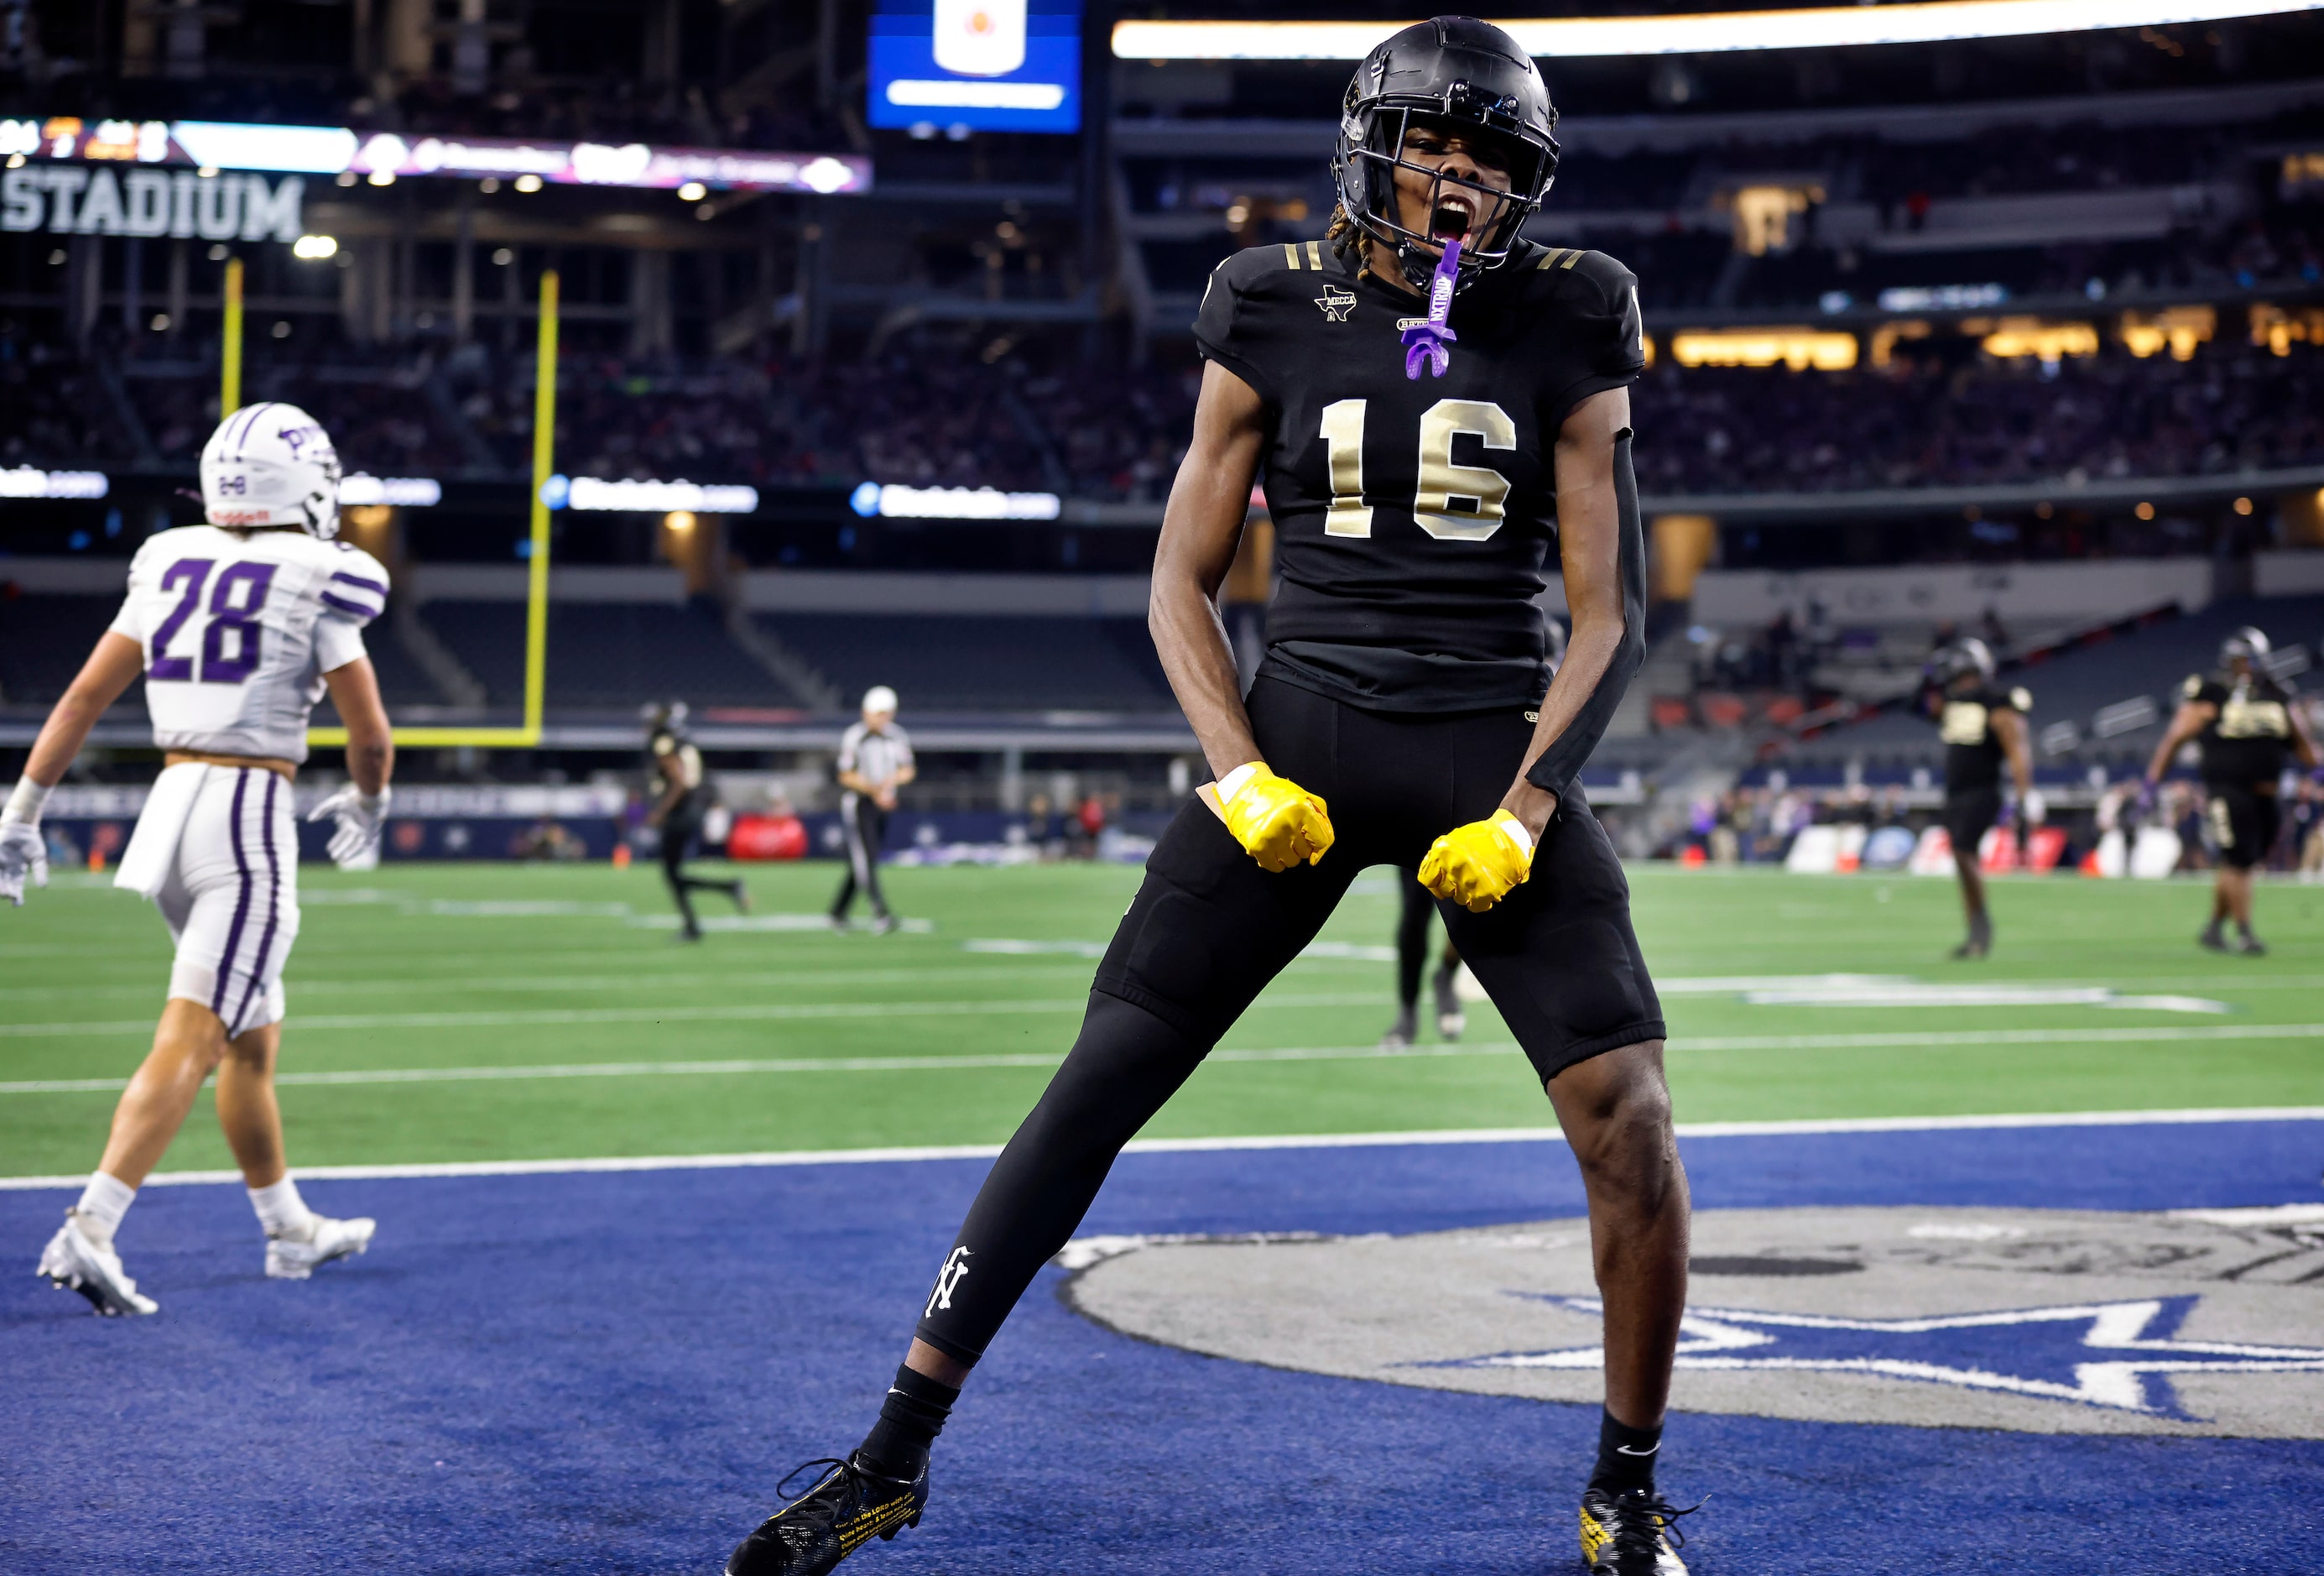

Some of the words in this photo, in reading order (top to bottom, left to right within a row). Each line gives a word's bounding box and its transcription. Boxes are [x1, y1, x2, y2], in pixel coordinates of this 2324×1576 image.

[0, 165, 306, 244] STADIUM
[1326, 295, 1354, 306] MECCA
[1430, 278, 1452, 321] NXTRND
[1318, 398, 1518, 542] 16
[147, 557, 280, 684] 28
[861, 1511, 872, 1521] the
[871, 1503, 889, 1515] LORD
